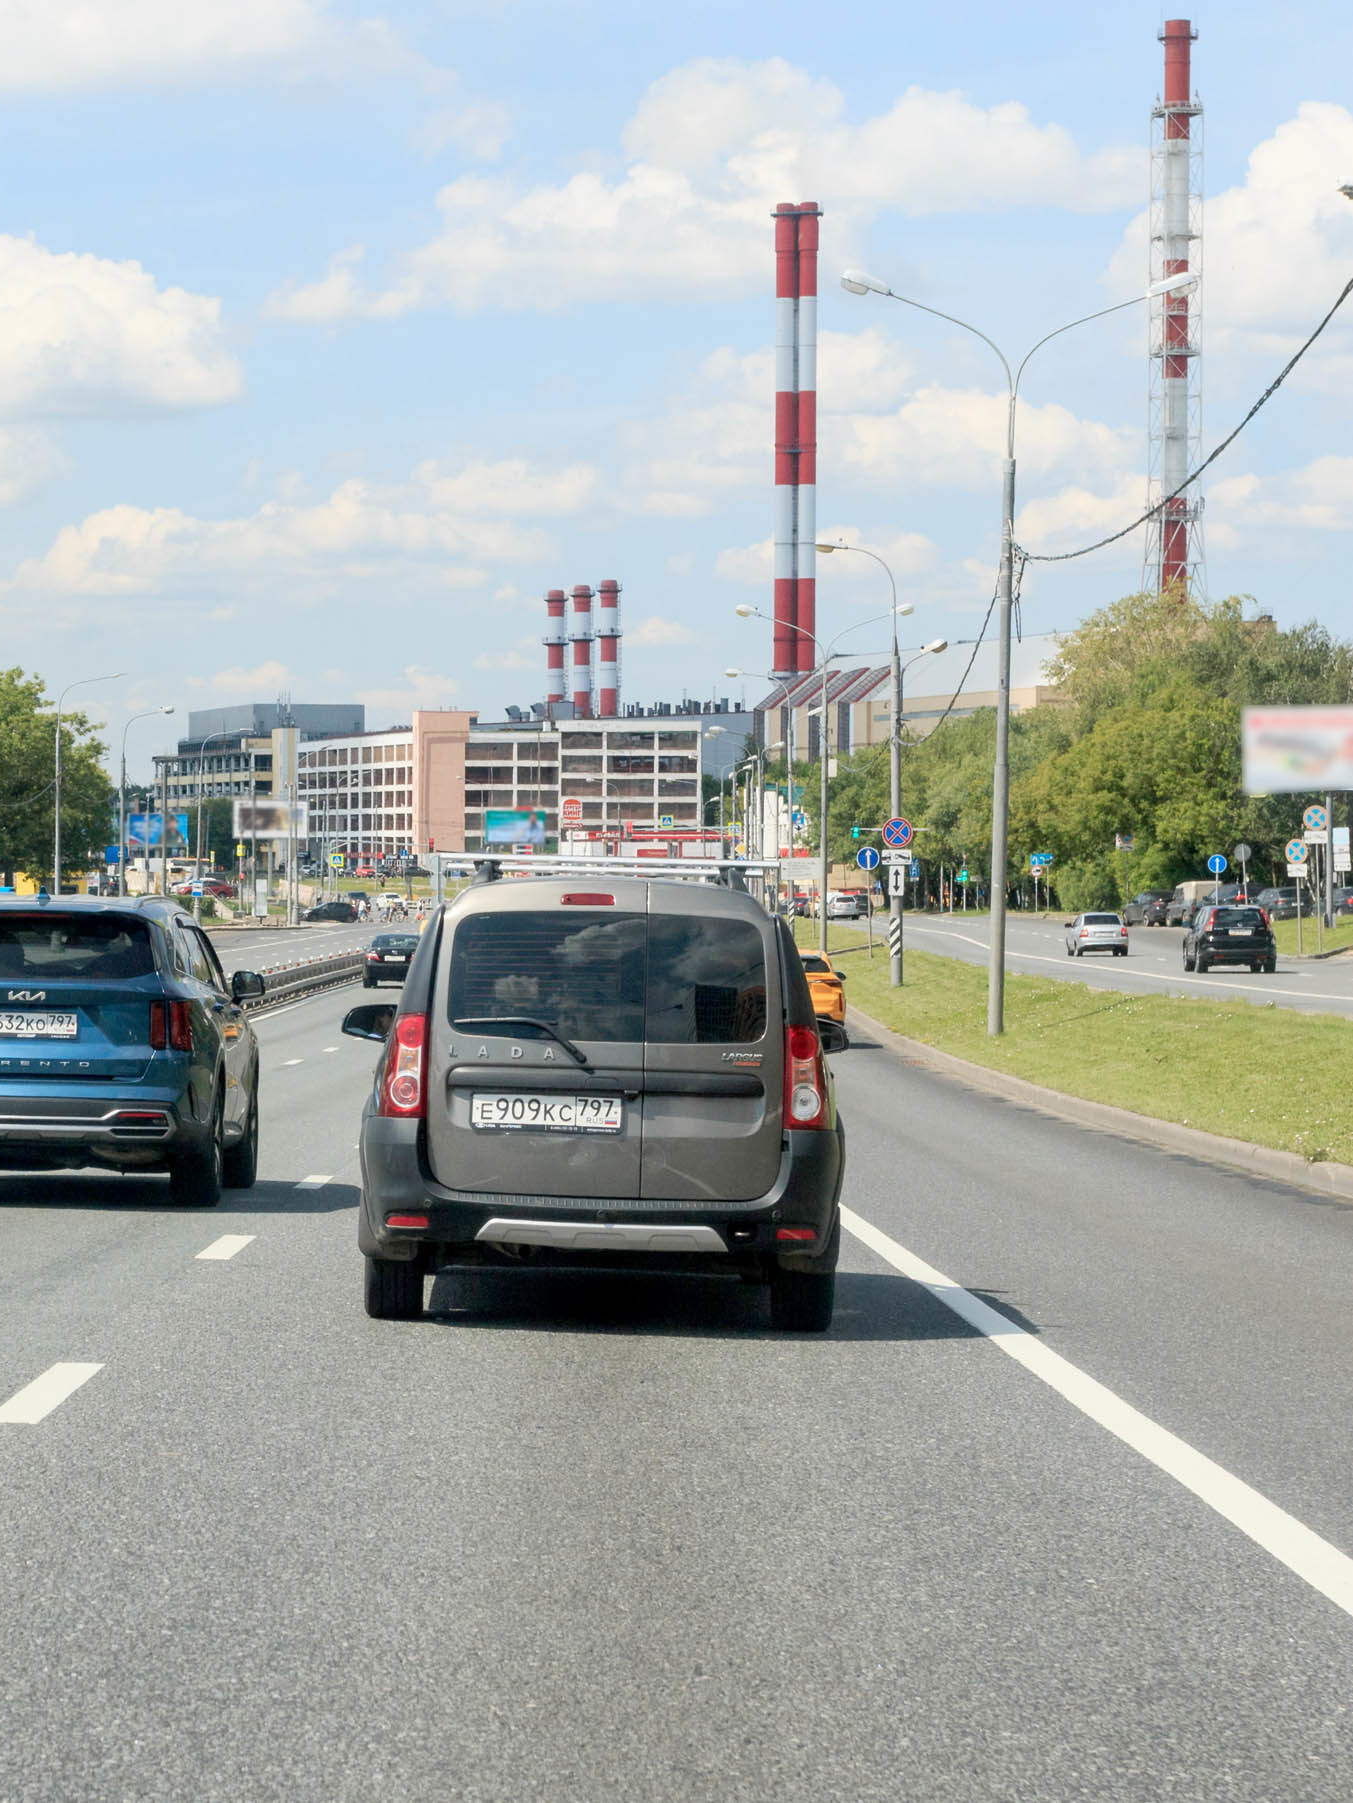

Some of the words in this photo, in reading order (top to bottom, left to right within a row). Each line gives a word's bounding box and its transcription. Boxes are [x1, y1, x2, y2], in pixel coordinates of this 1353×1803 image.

[49, 1015, 73, 1027] 797
[448, 1044, 556, 1060] LADA
[480, 1098, 573, 1122] Е909КС
[577, 1099, 615, 1117] 797
